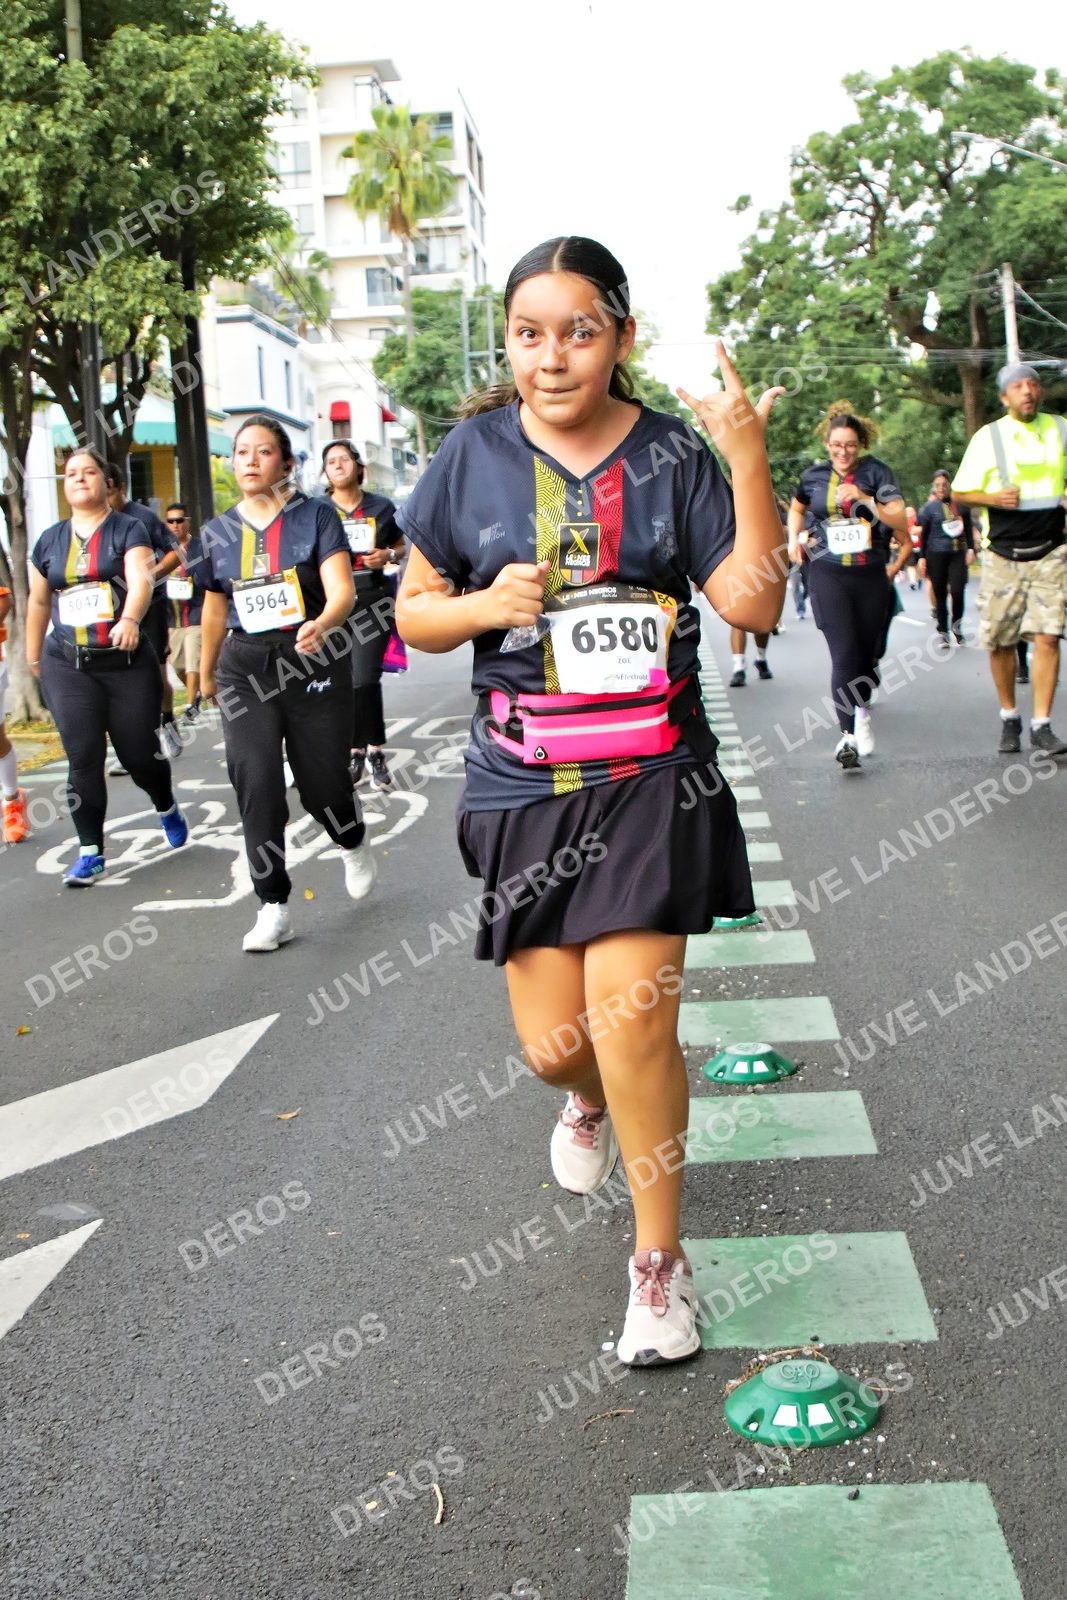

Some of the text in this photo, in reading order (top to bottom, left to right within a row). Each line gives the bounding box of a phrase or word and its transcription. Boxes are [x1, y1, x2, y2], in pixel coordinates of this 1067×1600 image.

[834, 529, 861, 542] 4261
[246, 589, 288, 613] 5964
[571, 617, 658, 653] 6580
